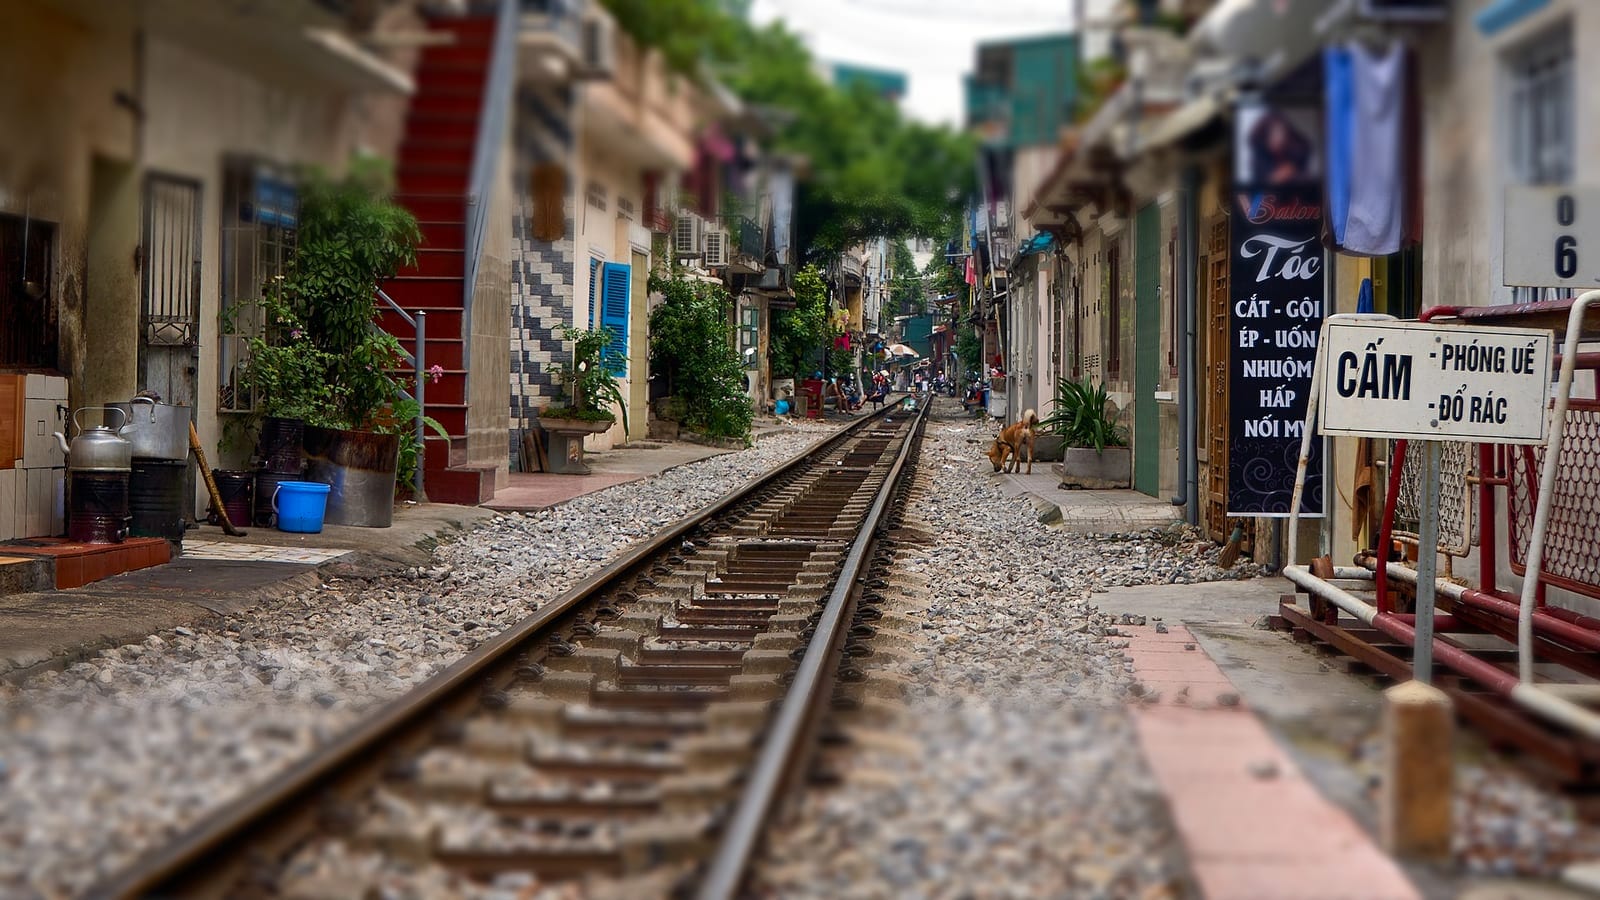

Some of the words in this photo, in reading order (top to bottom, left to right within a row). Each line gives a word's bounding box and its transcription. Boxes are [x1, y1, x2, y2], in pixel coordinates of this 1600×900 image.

[1240, 234, 1320, 283] Tóc
[1235, 293, 1270, 318] CẮT
[1286, 296, 1320, 322] GỘI
[1239, 326, 1259, 348] ÉP
[1275, 324, 1316, 348] UỐN
[1243, 356, 1312, 382] NHUỘM
[1336, 338, 1413, 401] CẤM
[1511, 339, 1539, 375] UẾ
[1259, 384, 1296, 408] HẤP
[1469, 391, 1508, 424] RÁC
[1244, 413, 1279, 438] NỐI
